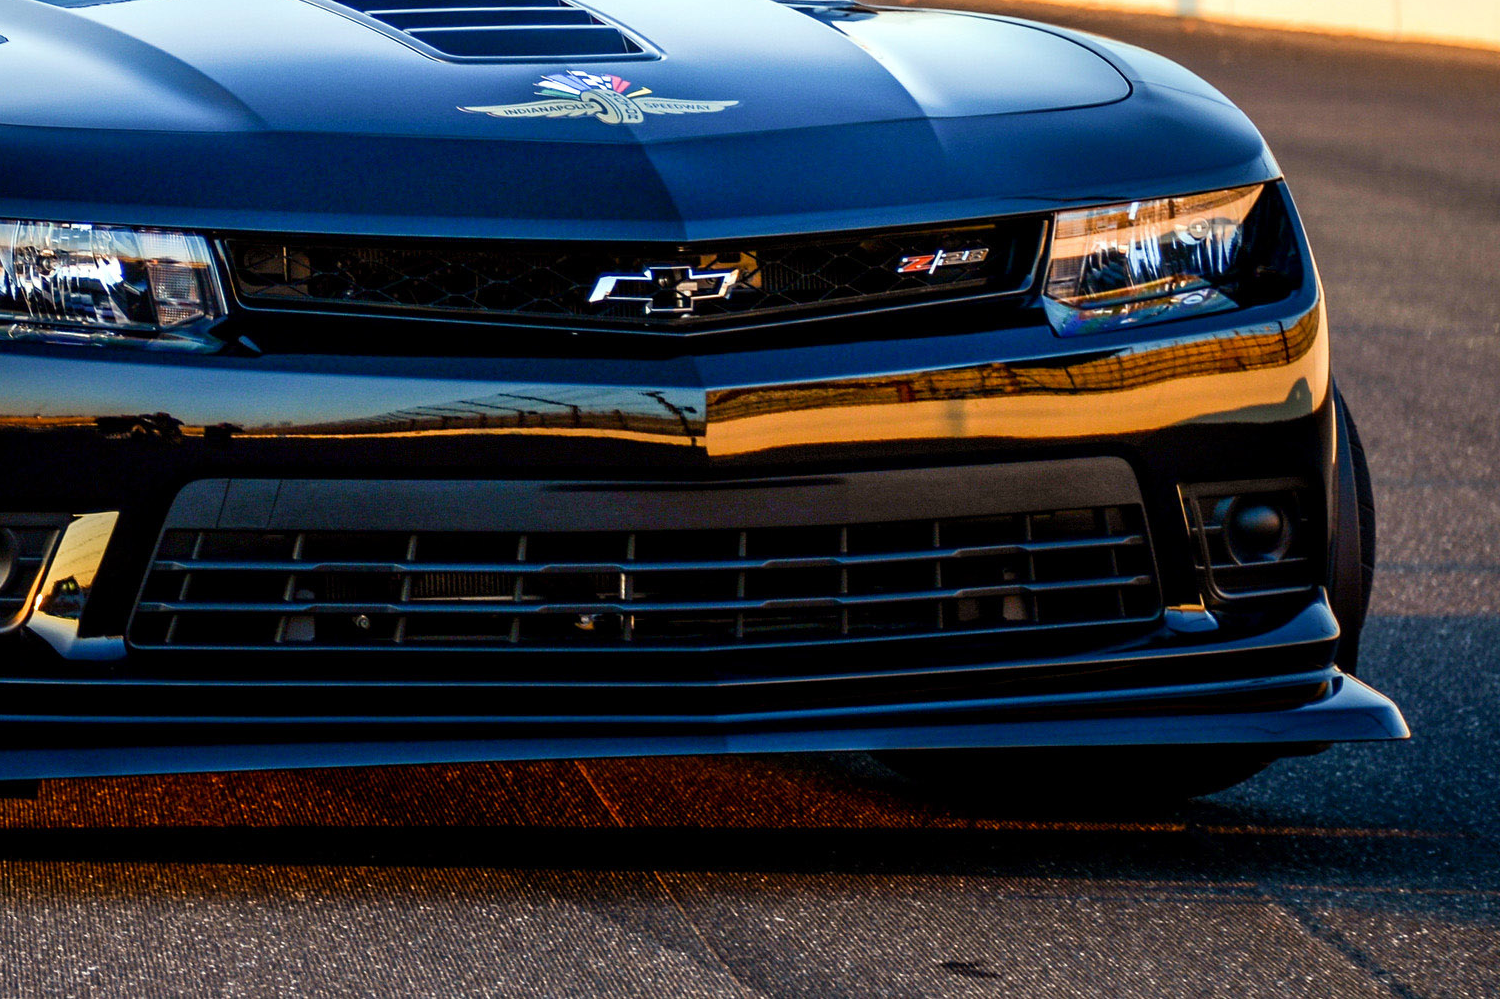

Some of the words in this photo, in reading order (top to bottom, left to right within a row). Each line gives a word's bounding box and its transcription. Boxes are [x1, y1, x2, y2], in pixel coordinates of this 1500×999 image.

[503, 102, 594, 116] INDIANAPOLIS
[644, 102, 711, 111] SPEEDWAY
[897, 249, 989, 275] Z/28
